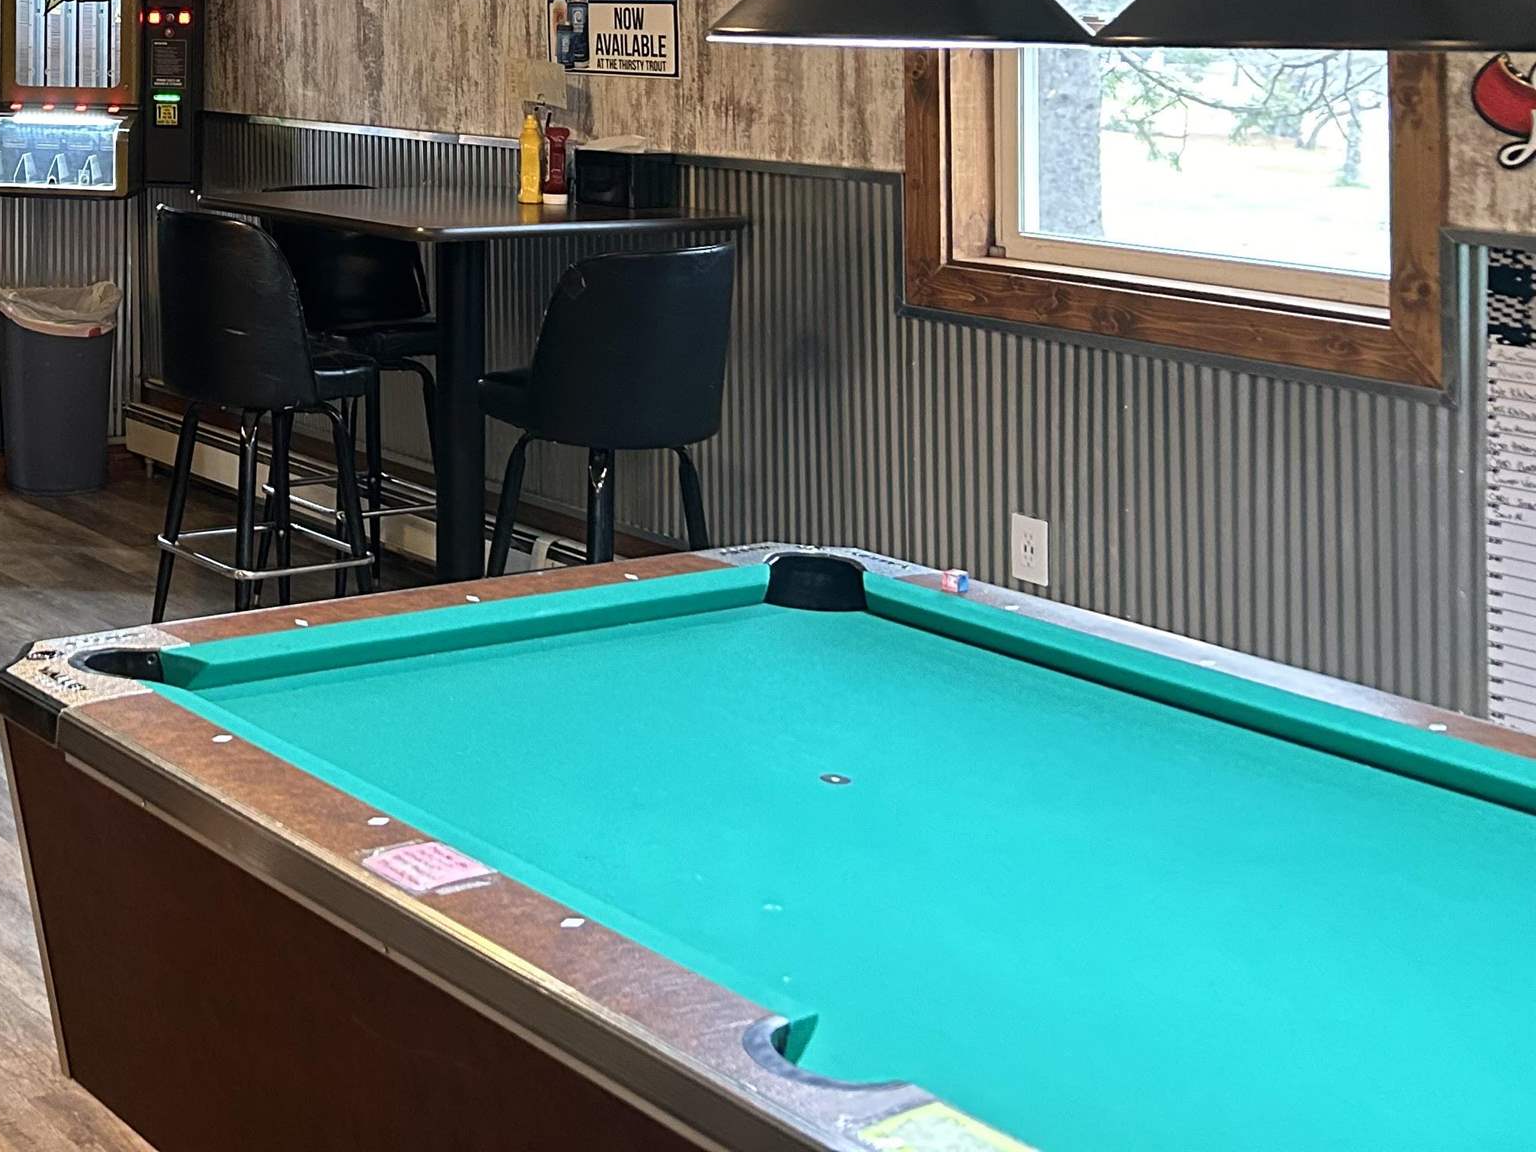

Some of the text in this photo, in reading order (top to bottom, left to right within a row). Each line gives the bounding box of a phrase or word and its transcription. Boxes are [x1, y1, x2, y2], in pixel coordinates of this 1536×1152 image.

[614, 7, 644, 31] NOW
[595, 32, 667, 58] AVAILABLE
[597, 58, 666, 72] AT THE THIRSTY TROUT
